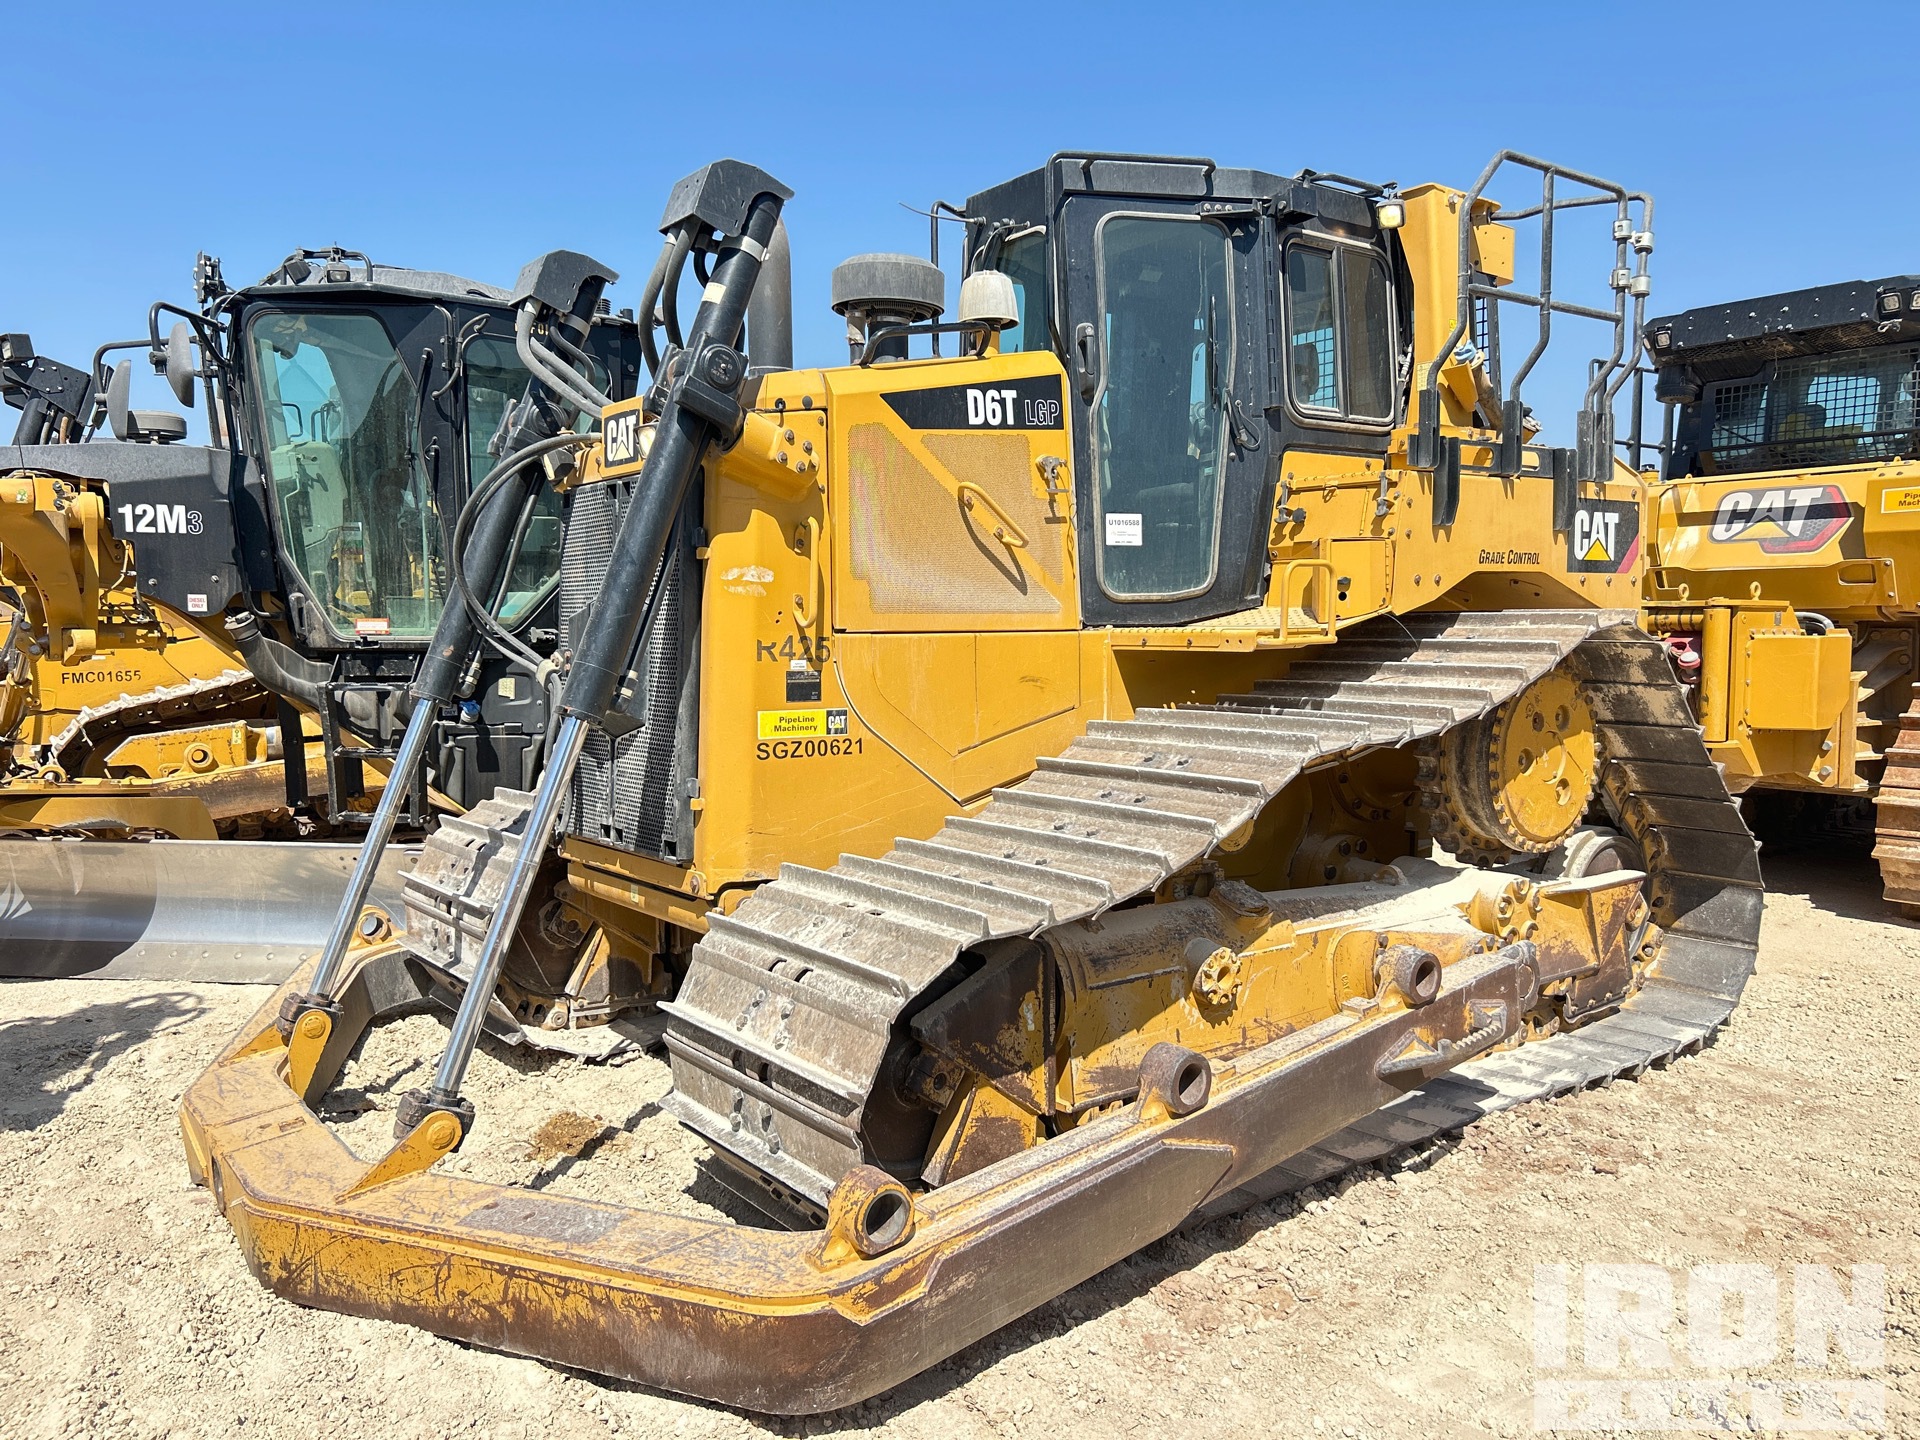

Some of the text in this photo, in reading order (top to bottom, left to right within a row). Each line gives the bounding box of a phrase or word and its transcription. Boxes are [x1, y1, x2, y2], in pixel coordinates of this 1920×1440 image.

[966, 388, 1060, 426] D6T LGP
[607, 415, 637, 461] CAT
[118, 503, 204, 535] 12M3
[1712, 487, 1824, 541] CAT
[1574, 510, 1619, 561] CAT
[756, 635, 831, 663] R425
[61, 670, 142, 684] FMC01655
[774, 724, 818, 732] Machinery
[779, 716, 815, 724] PipeLine
[828, 715, 847, 728] CAT
[756, 738, 863, 760] SGZ00621
